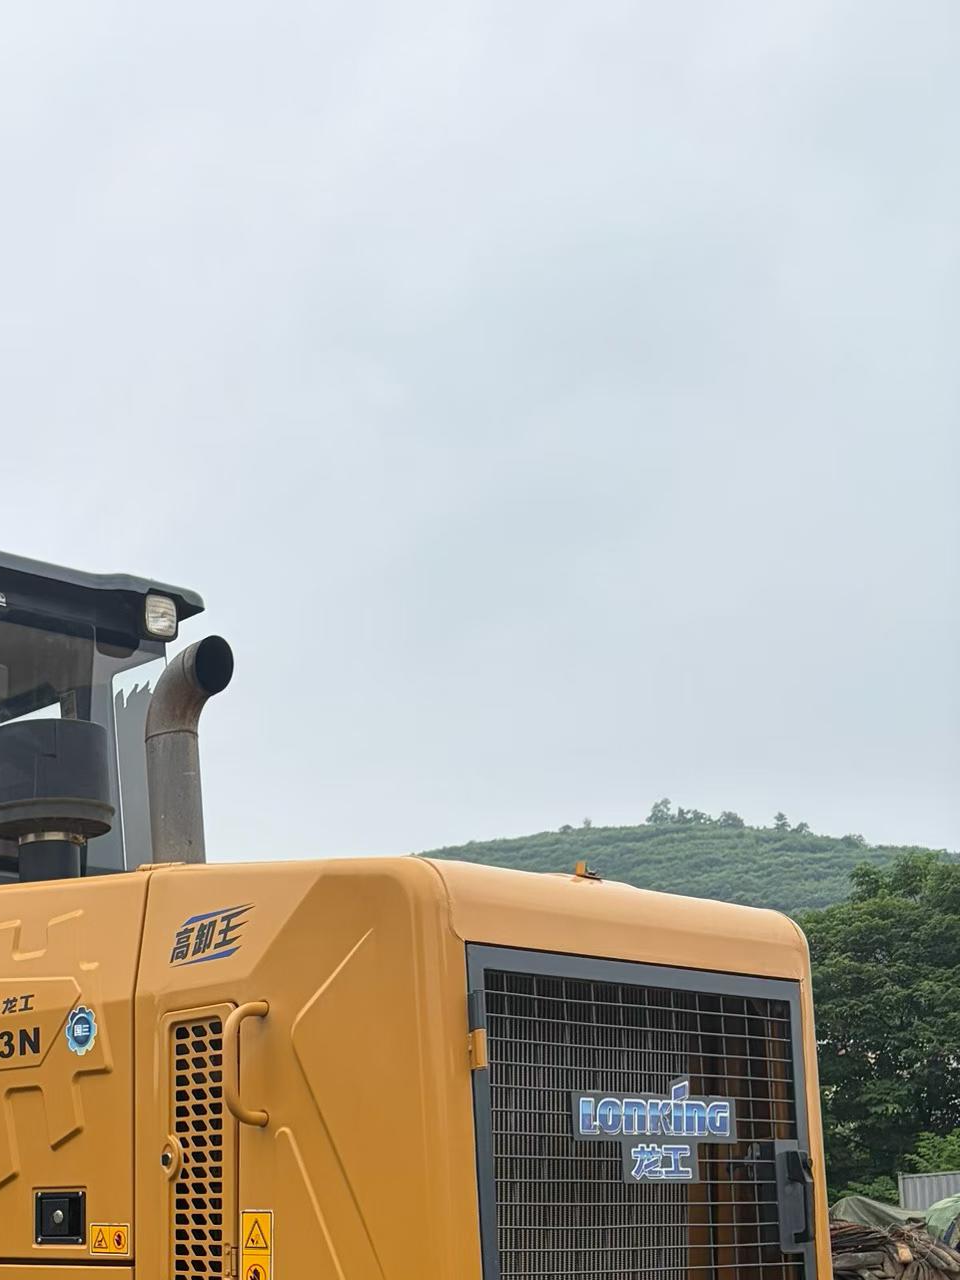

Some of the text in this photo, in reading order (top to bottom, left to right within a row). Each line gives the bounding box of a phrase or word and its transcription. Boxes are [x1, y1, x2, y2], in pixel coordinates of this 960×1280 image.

[169, 904, 256, 964] 高卸王
[1, 994, 35, 1015] 龙工
[631, 1144, 692, 1180] 龙工
